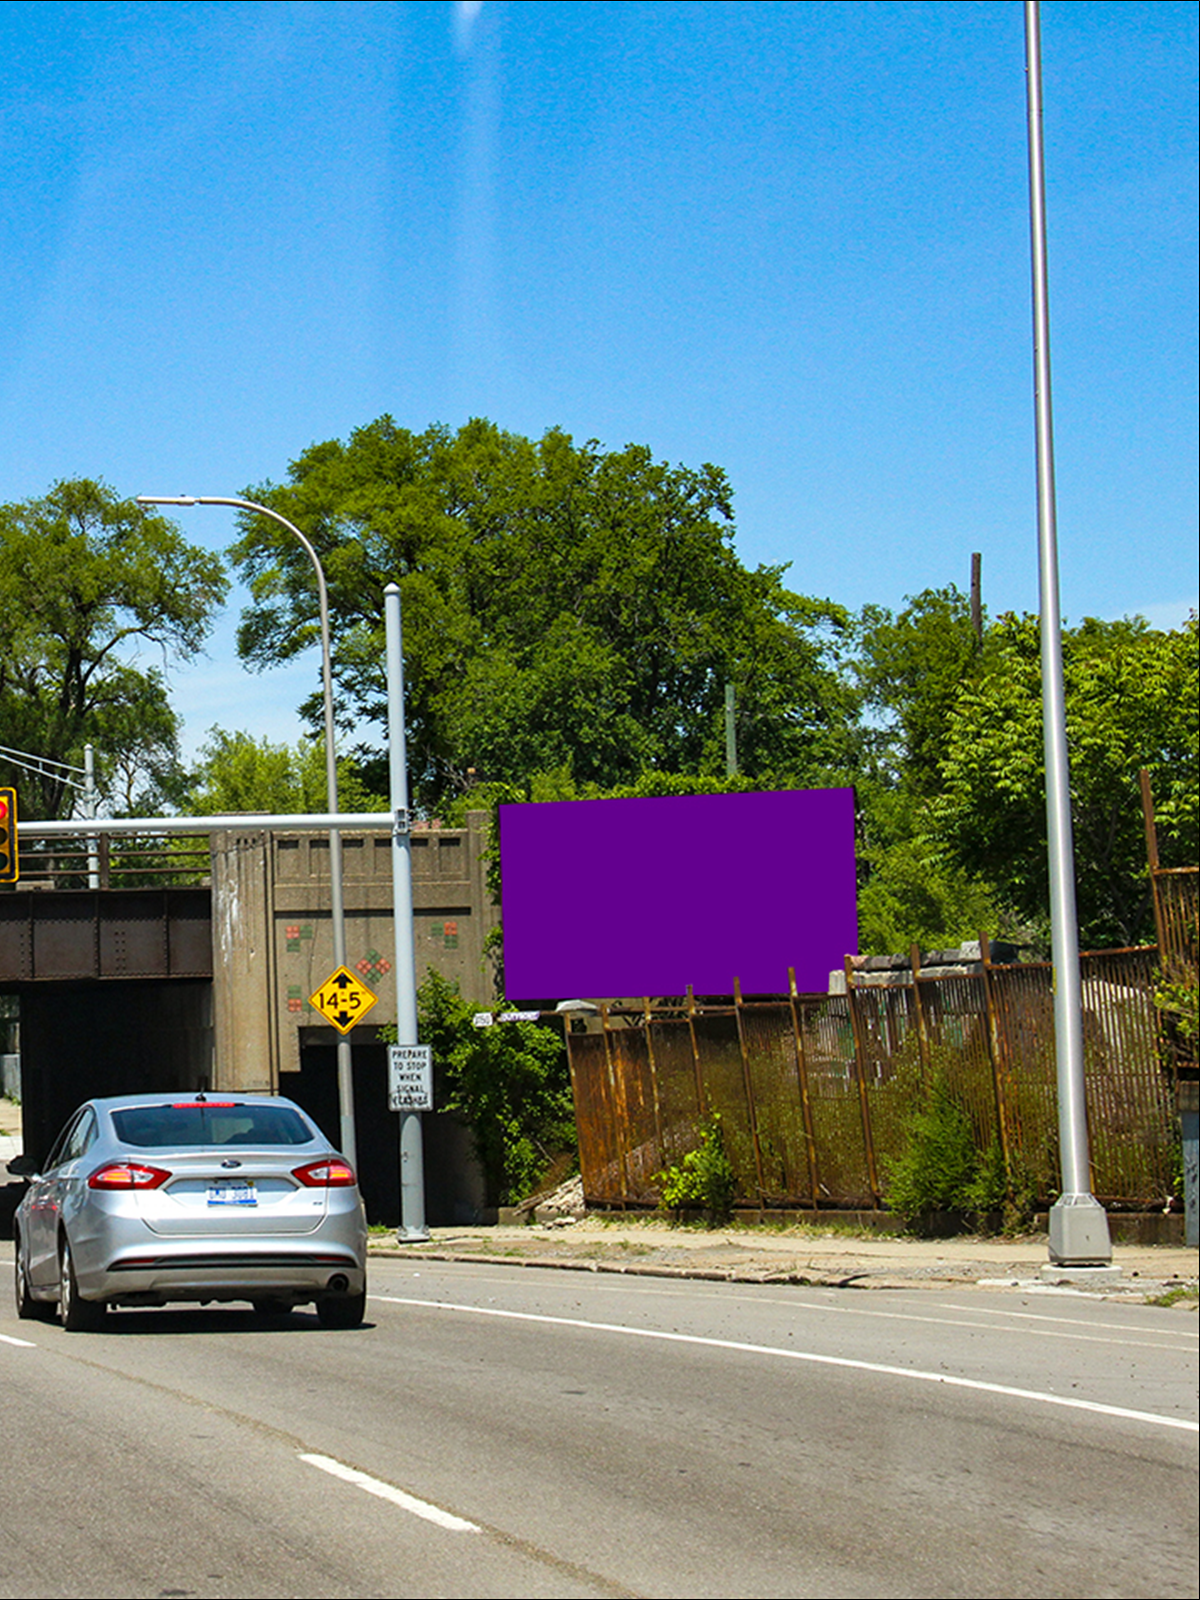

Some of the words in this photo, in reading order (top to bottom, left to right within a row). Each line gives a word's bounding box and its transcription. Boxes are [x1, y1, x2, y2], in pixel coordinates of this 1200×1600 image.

[392, 1049, 428, 1060] PREPARE
[394, 1061, 404, 1070] TO
[406, 1061, 427, 1070] STOP
[399, 1072, 422, 1081] WHEN
[396, 1084, 425, 1094] SIGNAL
